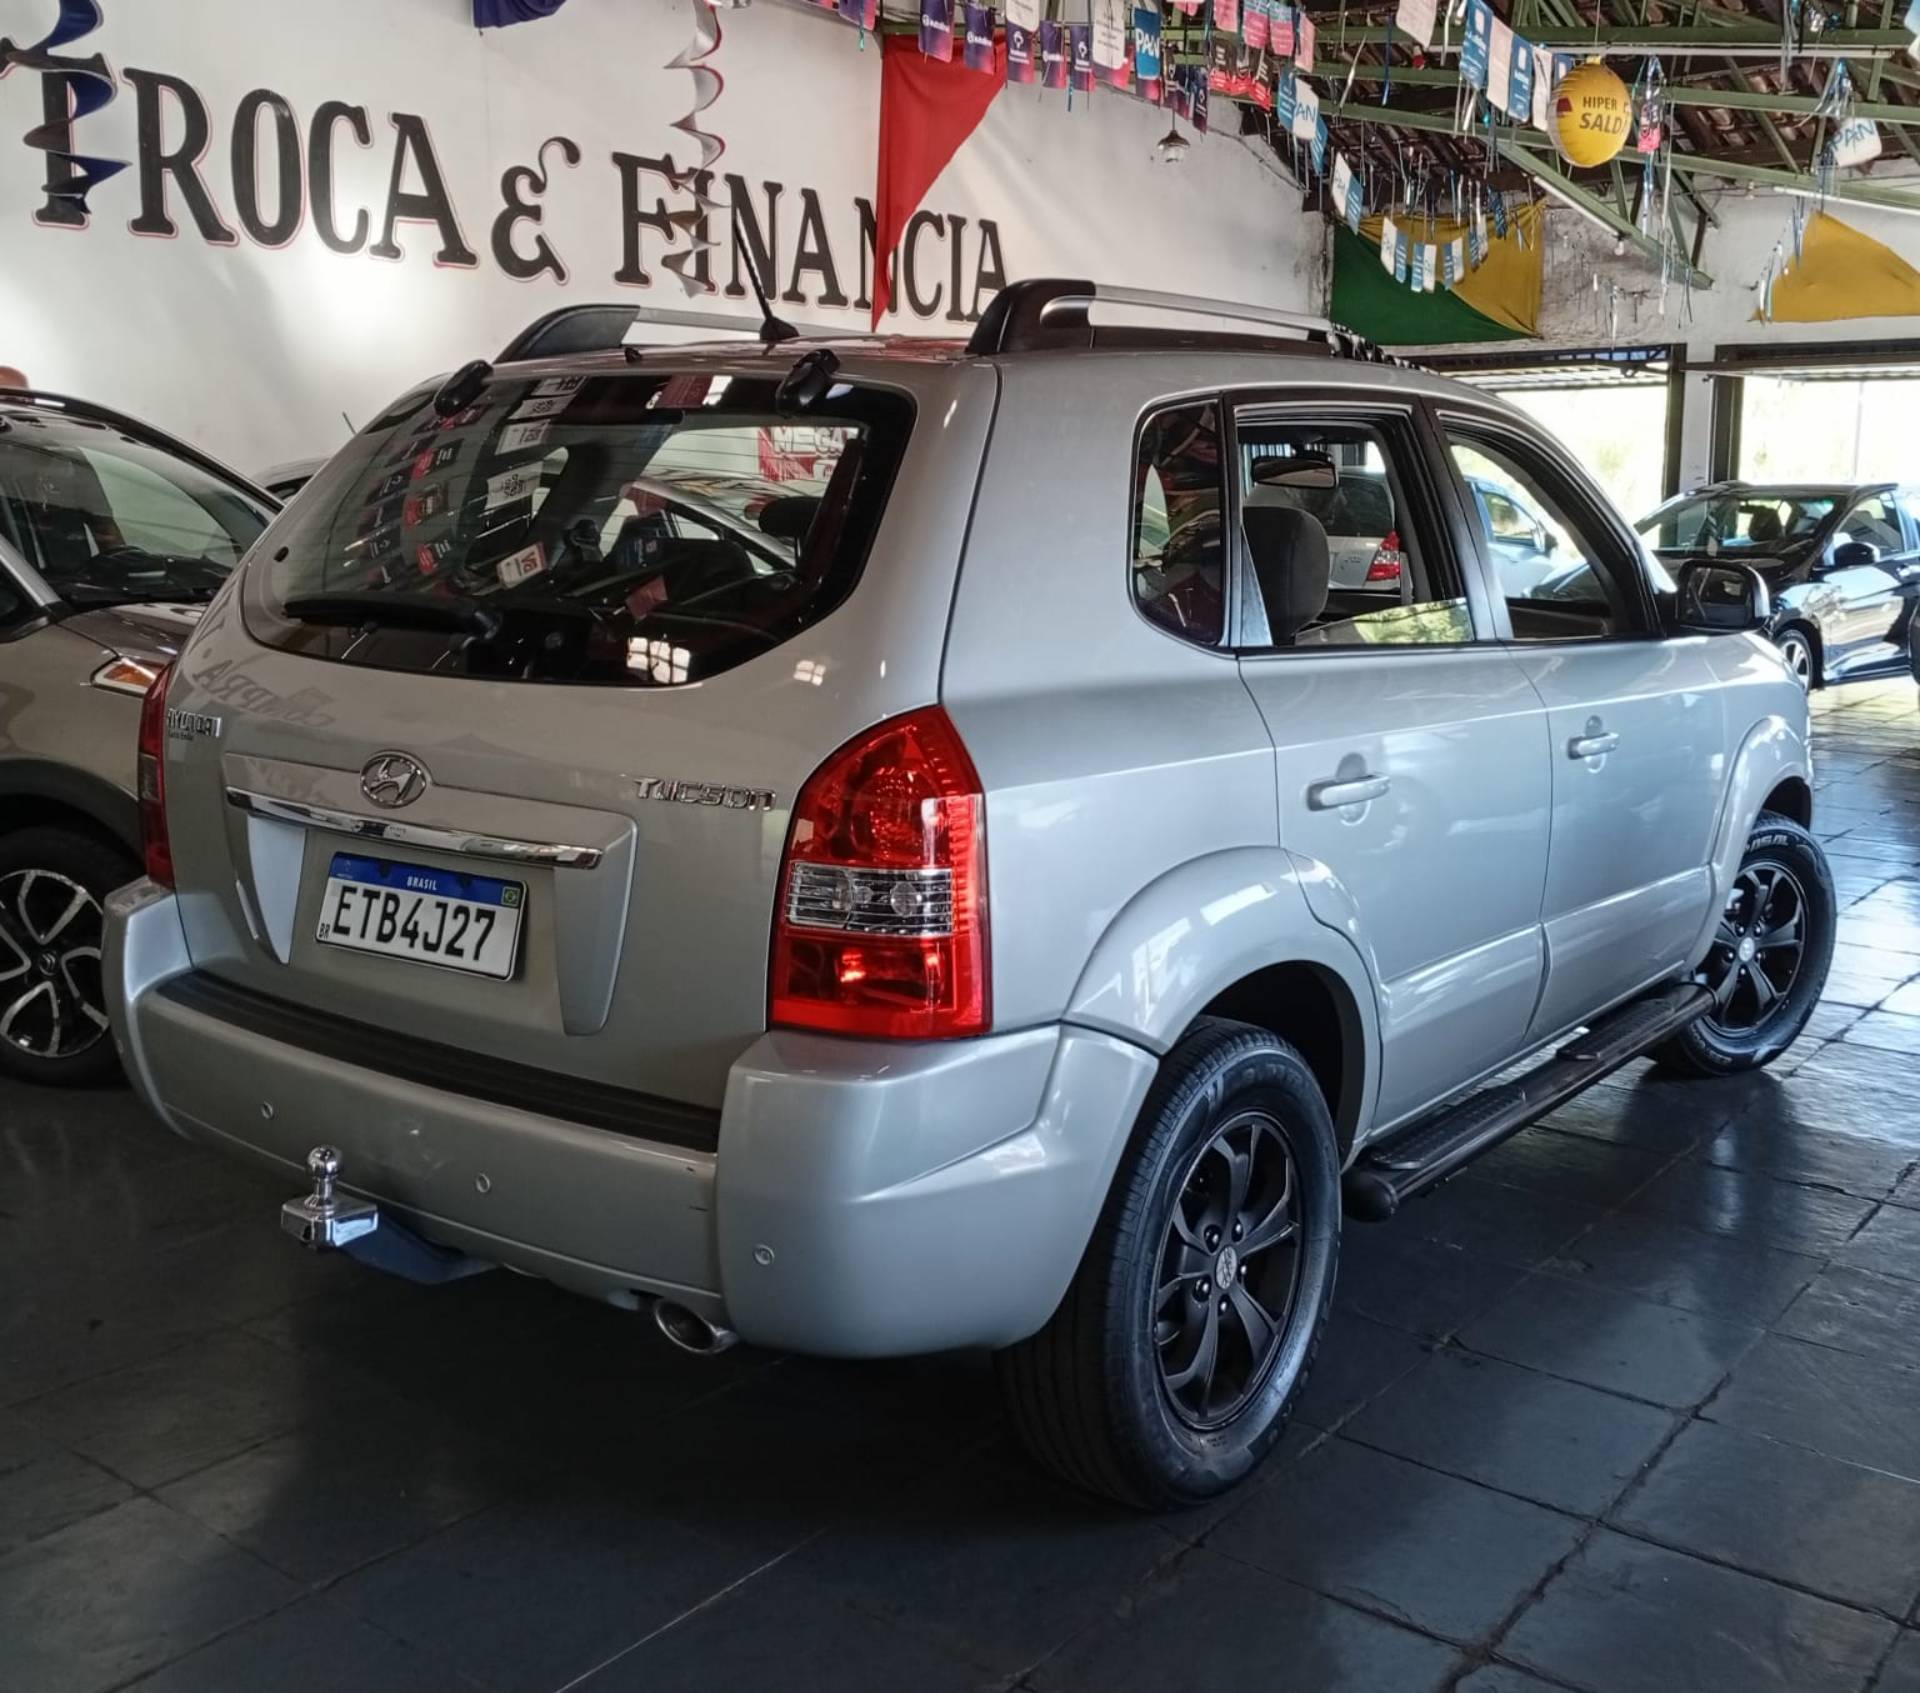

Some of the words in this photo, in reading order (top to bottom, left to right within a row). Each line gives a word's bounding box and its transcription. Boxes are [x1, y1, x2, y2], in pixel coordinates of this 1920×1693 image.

[1135, 28, 1160, 59] PAN
[1295, 103, 1317, 122] AN
[1582, 96, 1617, 111] HIPER
[1579, 112, 1627, 134] SALD
[1829, 120, 1874, 151] PAN
[0, 37, 477, 266] TROCA
[491, 136, 580, 281] &
[612, 152, 1008, 323] FINANCIA
[406, 876, 437, 891] BRASIL
[319, 922, 331, 939] BR
[332, 885, 496, 961] ETB4J27
